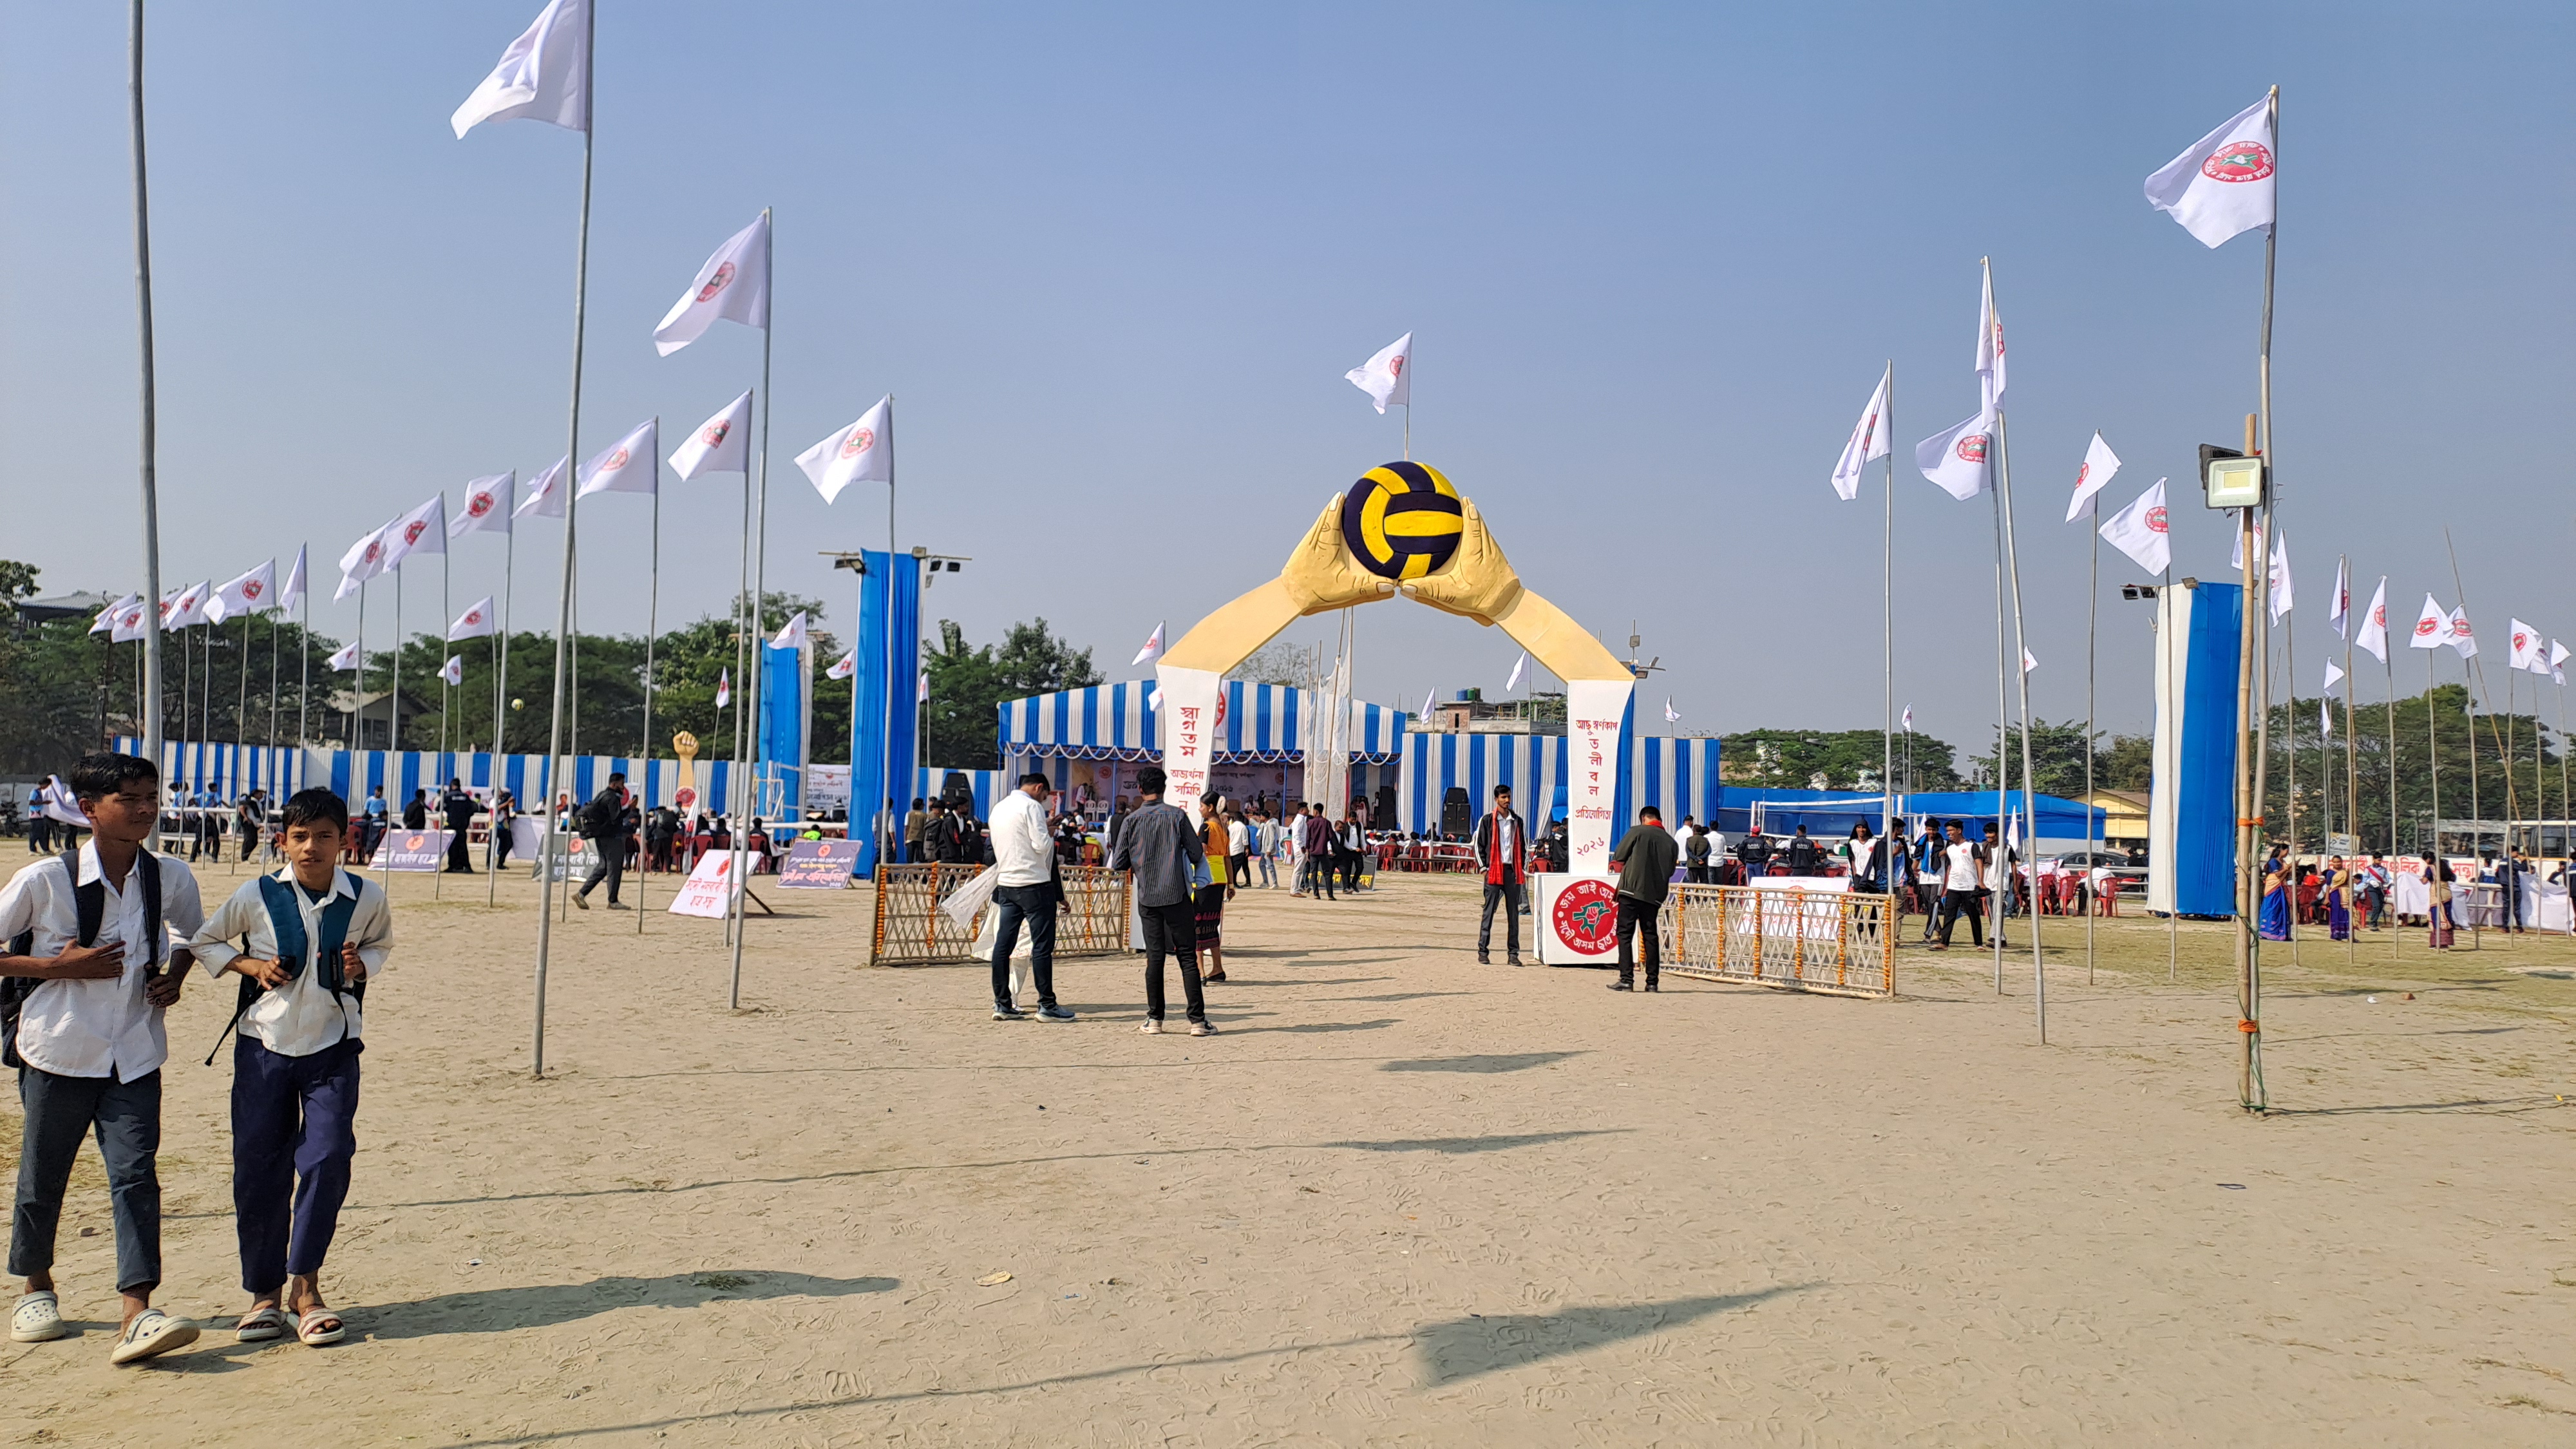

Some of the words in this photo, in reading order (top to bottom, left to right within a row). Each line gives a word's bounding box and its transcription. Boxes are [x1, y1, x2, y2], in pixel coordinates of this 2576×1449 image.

[1173, 782, 1201, 796] সমিতি
[1577, 837, 1604, 857] ২০২৬
[1560, 891, 1576, 909] জয়
[1577, 881, 1598, 895] আই
[1559, 920, 1575, 941] সদৌ
[1573, 937, 1595, 951] অসম
